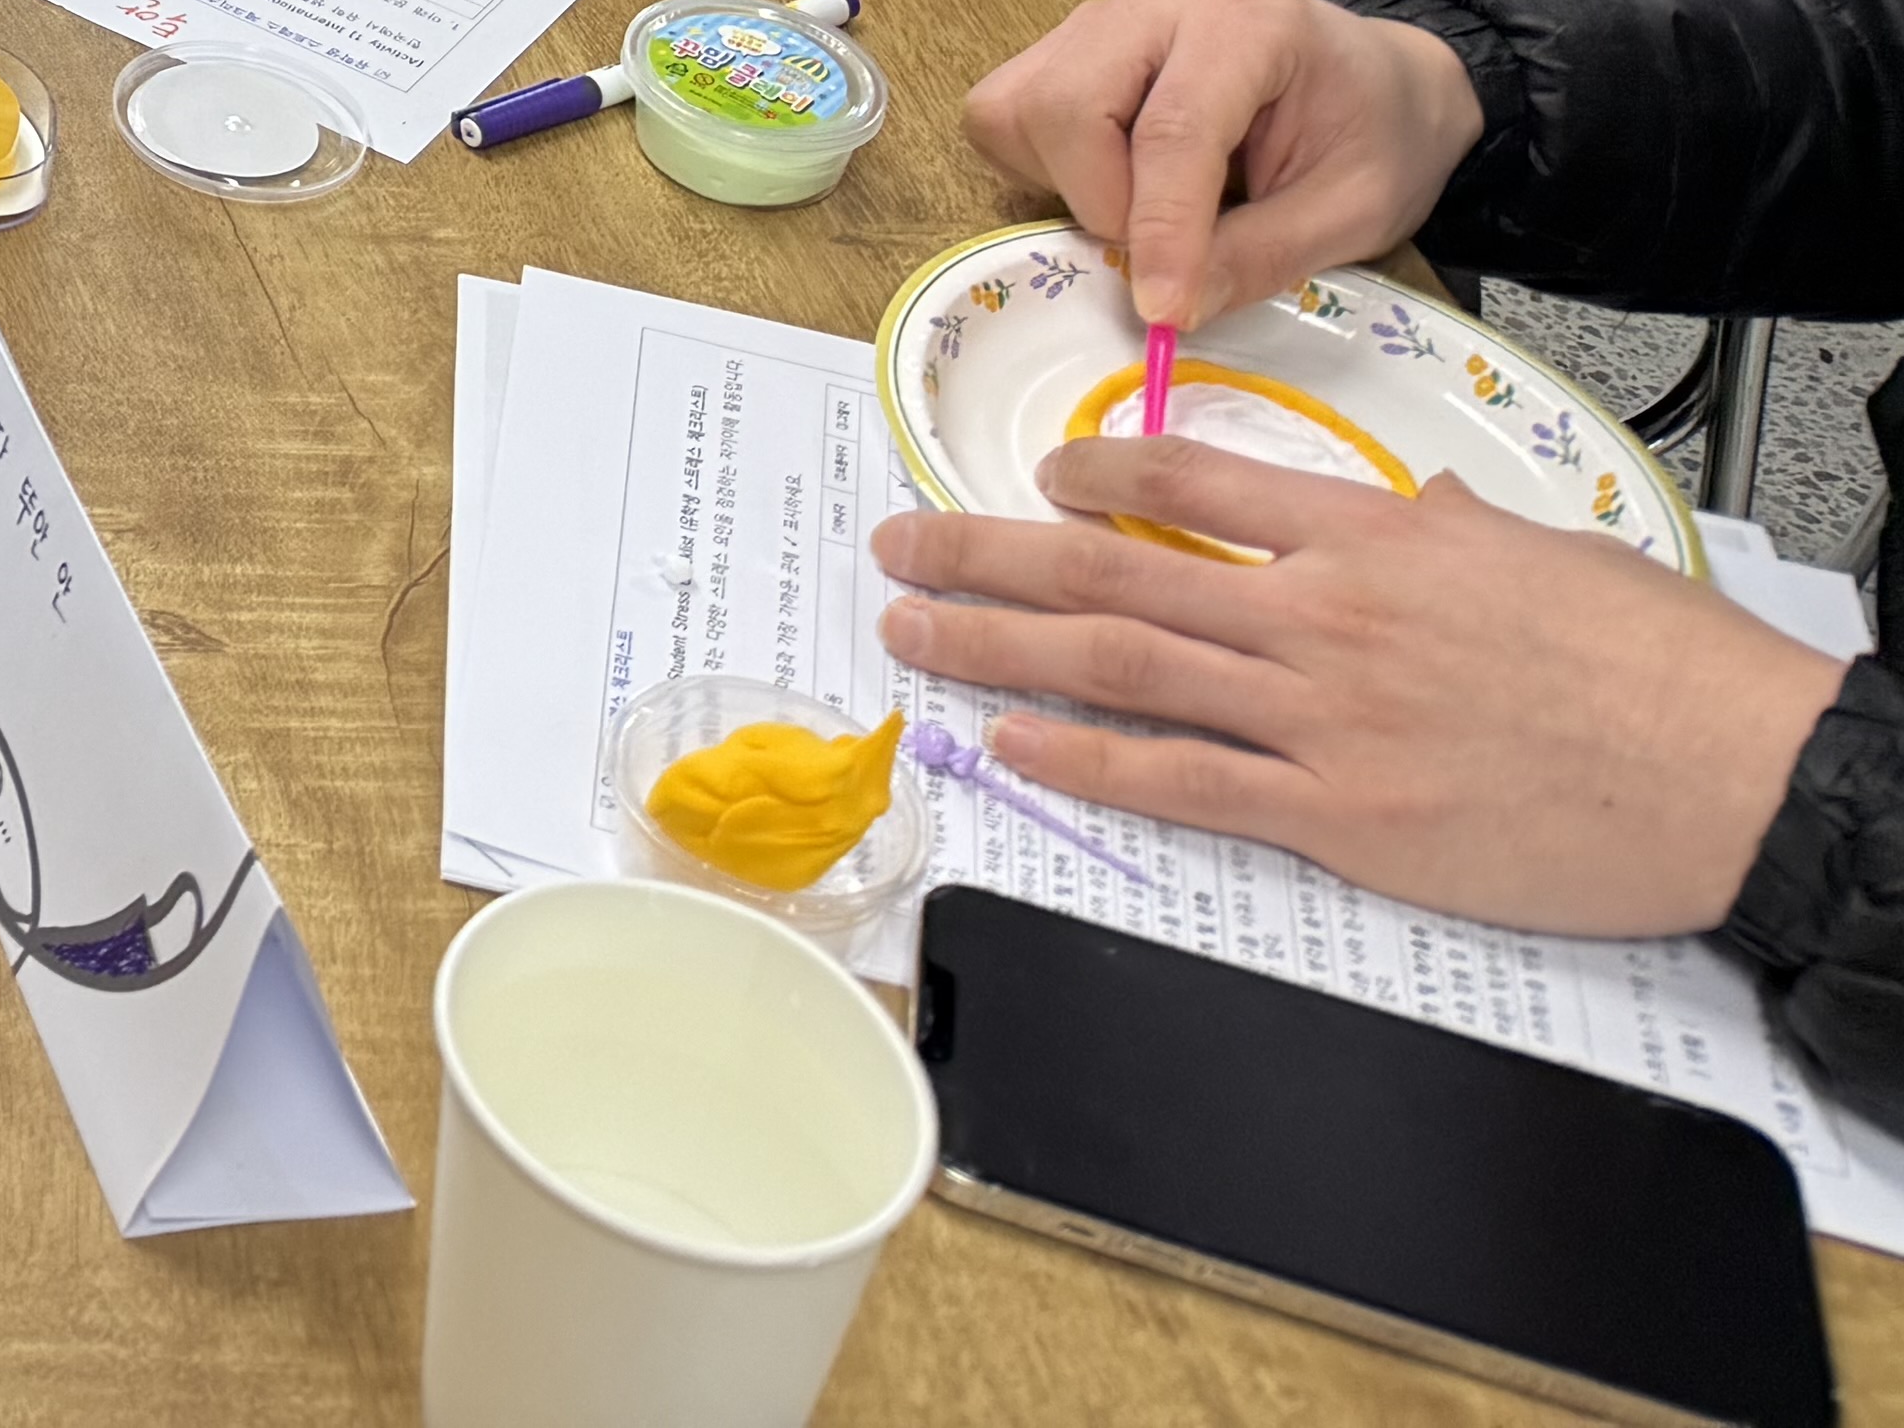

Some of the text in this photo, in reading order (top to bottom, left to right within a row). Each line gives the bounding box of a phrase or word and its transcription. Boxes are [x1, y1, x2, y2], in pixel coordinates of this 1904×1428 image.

[719, 416, 740, 460] 자기이해
[683, 446, 703, 490] 스트레스
[712, 513, 733, 547] 요인을
[52, 561, 74, 624] 안
[709, 552, 729, 599] 스트레스
[671, 590, 690, 631] Stress
[778, 579, 799, 616] 가까운
[705, 603, 727, 641] 다양한
[776, 620, 797, 646] 가장
[666, 634, 686, 680] Student
